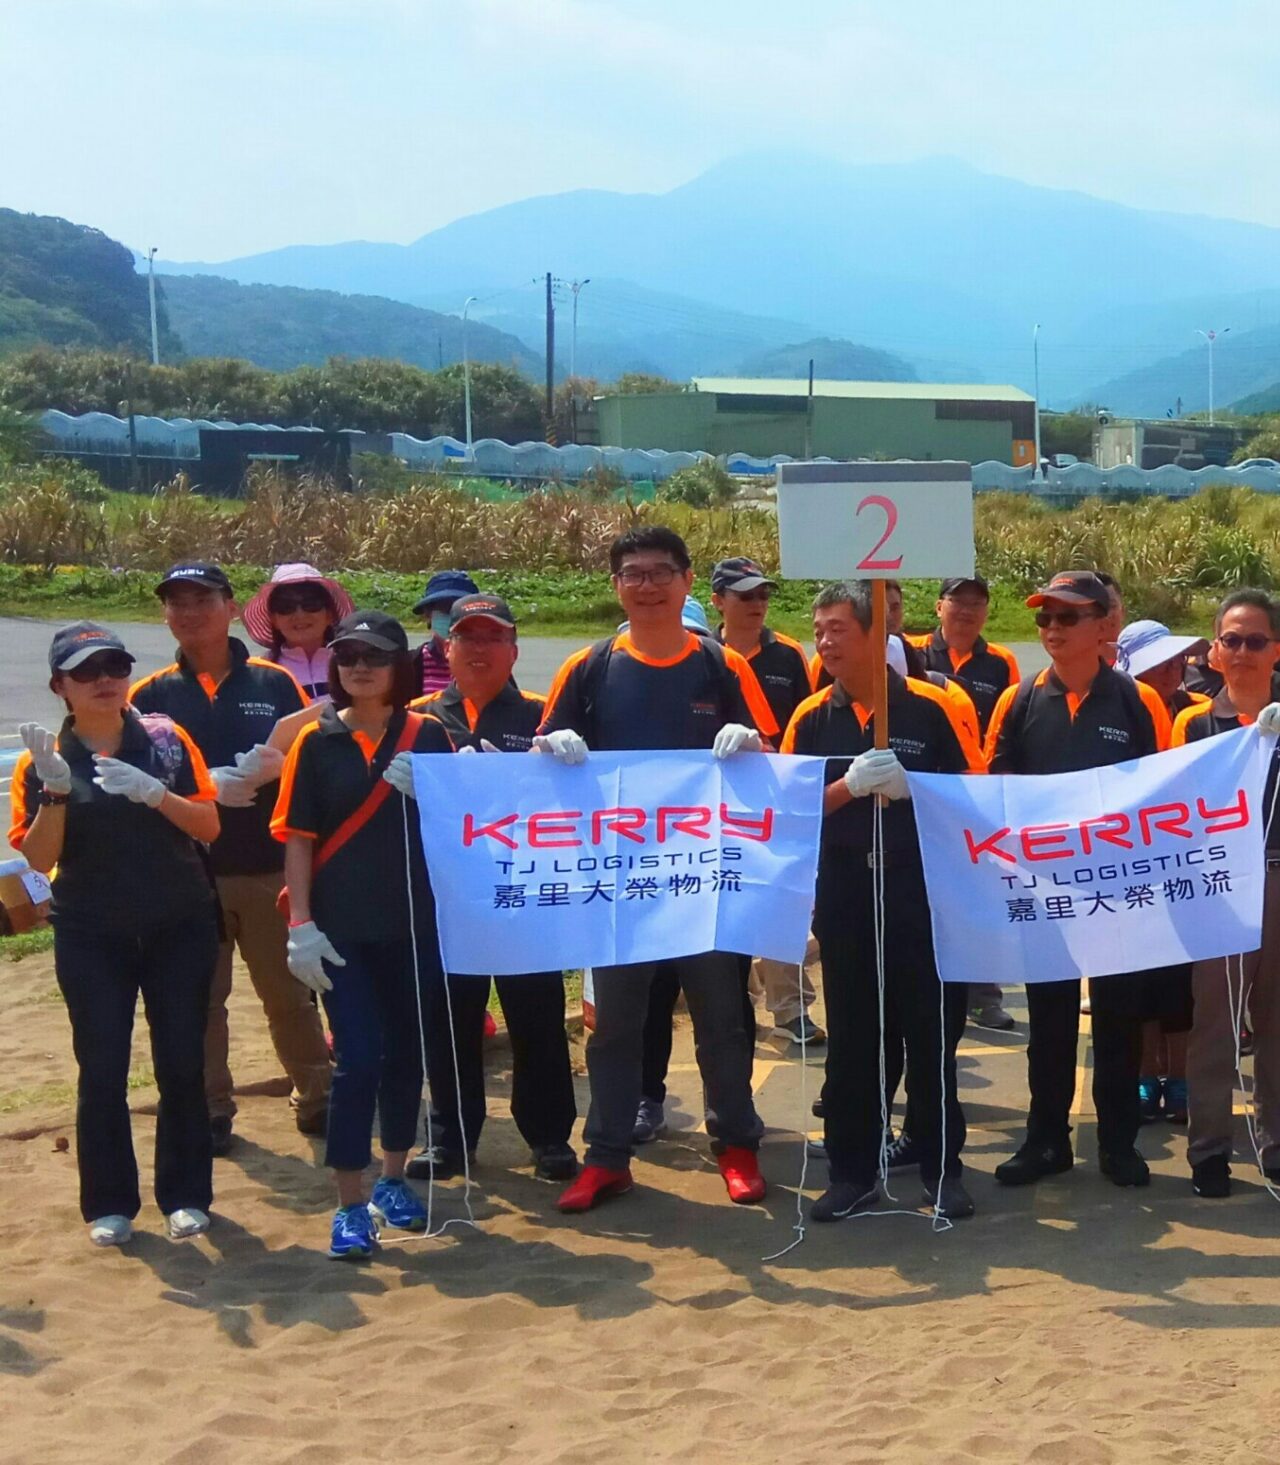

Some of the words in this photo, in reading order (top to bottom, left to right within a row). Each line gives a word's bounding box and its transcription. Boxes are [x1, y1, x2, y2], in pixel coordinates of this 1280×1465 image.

[856, 495, 903, 569] 2
[503, 732, 532, 743] KERR
[889, 737, 926, 749] KERRY
[463, 803, 774, 849] KERRY
[964, 789, 1250, 864] KERRY
[495, 861, 536, 875] TJ
[554, 847, 742, 873] LOGISTICS
[1001, 876, 1037, 889] TJ
[1054, 845, 1227, 885] LOGISTICS
[493, 870, 742, 909] 嘉里大榮物流
[1006, 870, 1232, 922] 嘉里大榮物流
